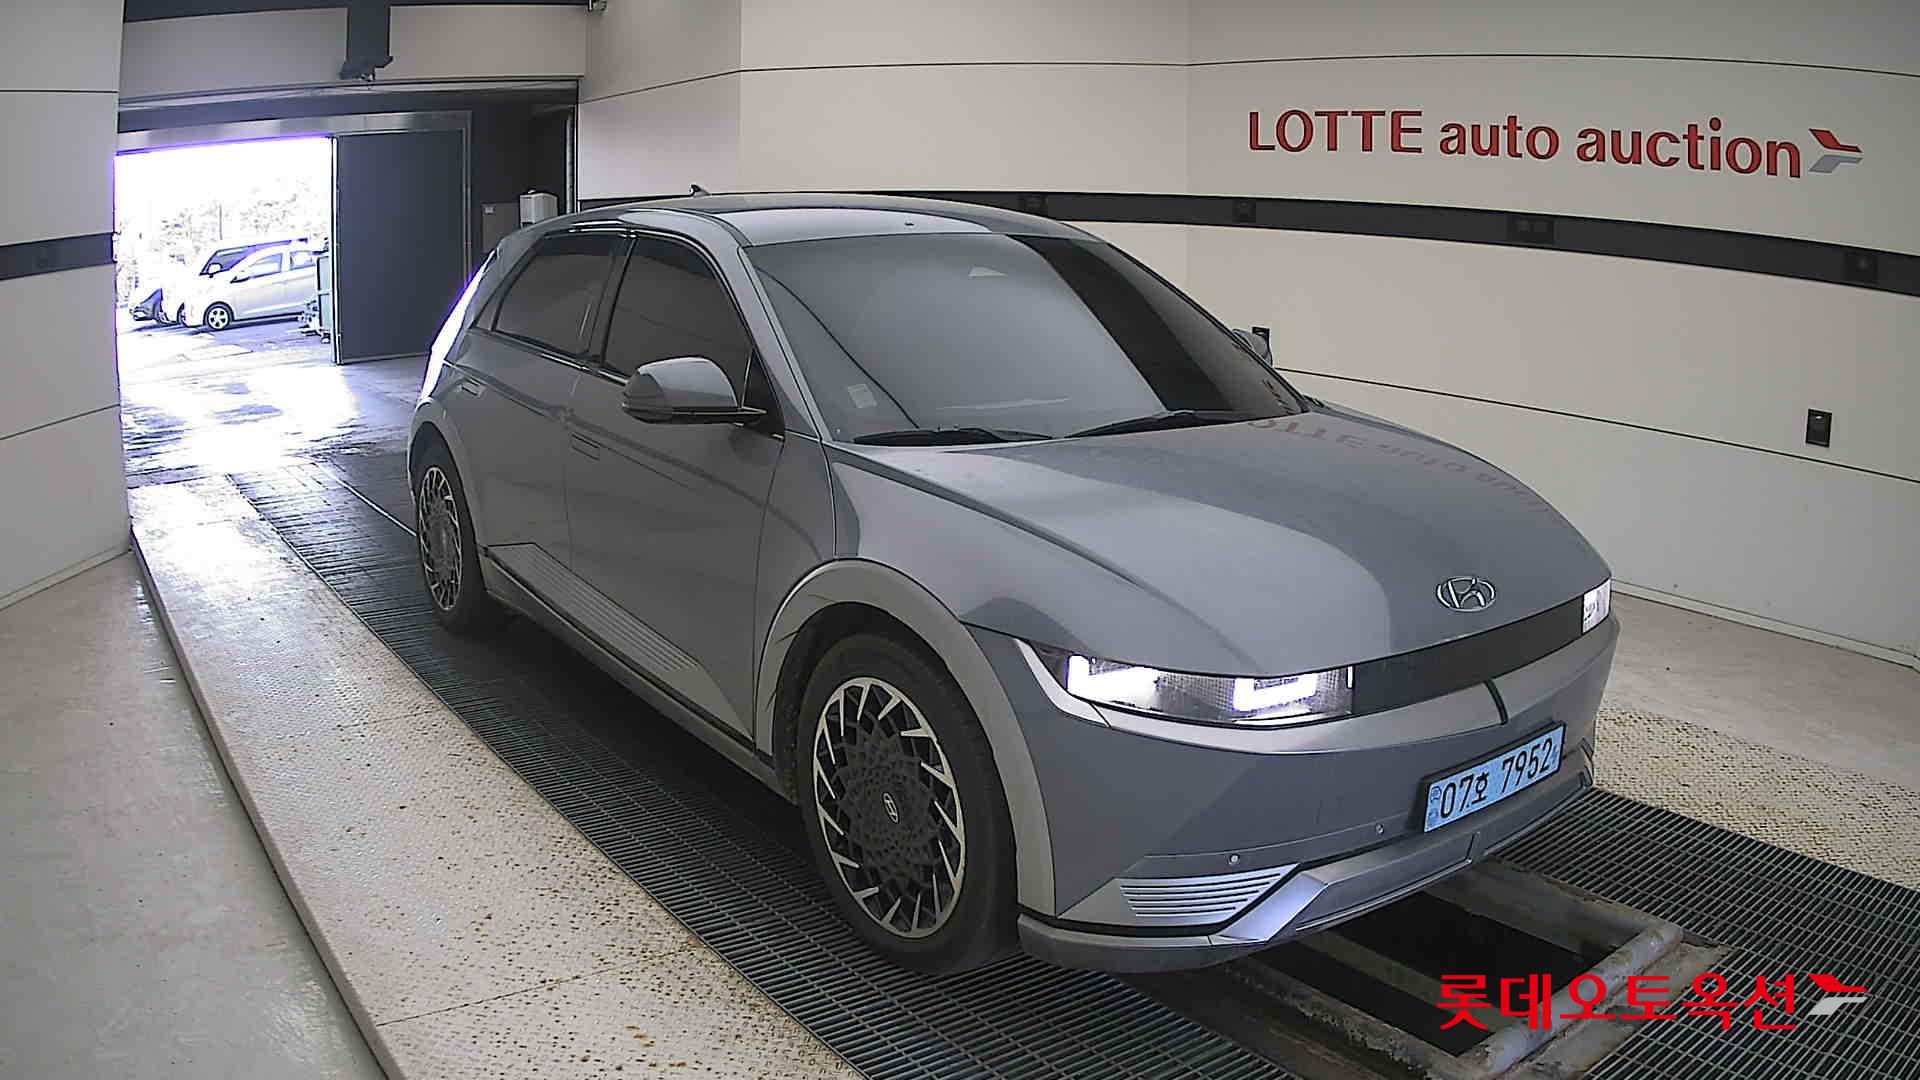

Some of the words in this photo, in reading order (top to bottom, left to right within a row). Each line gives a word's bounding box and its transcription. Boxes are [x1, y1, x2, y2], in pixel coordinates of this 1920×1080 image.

[1248, 110, 1422, 154] LOTTE
[1439, 115, 1560, 160] auto
[1576, 116, 1801, 179] auction
[1440, 771, 1490, 819] 07호
[1501, 737, 1553, 793] 7952
